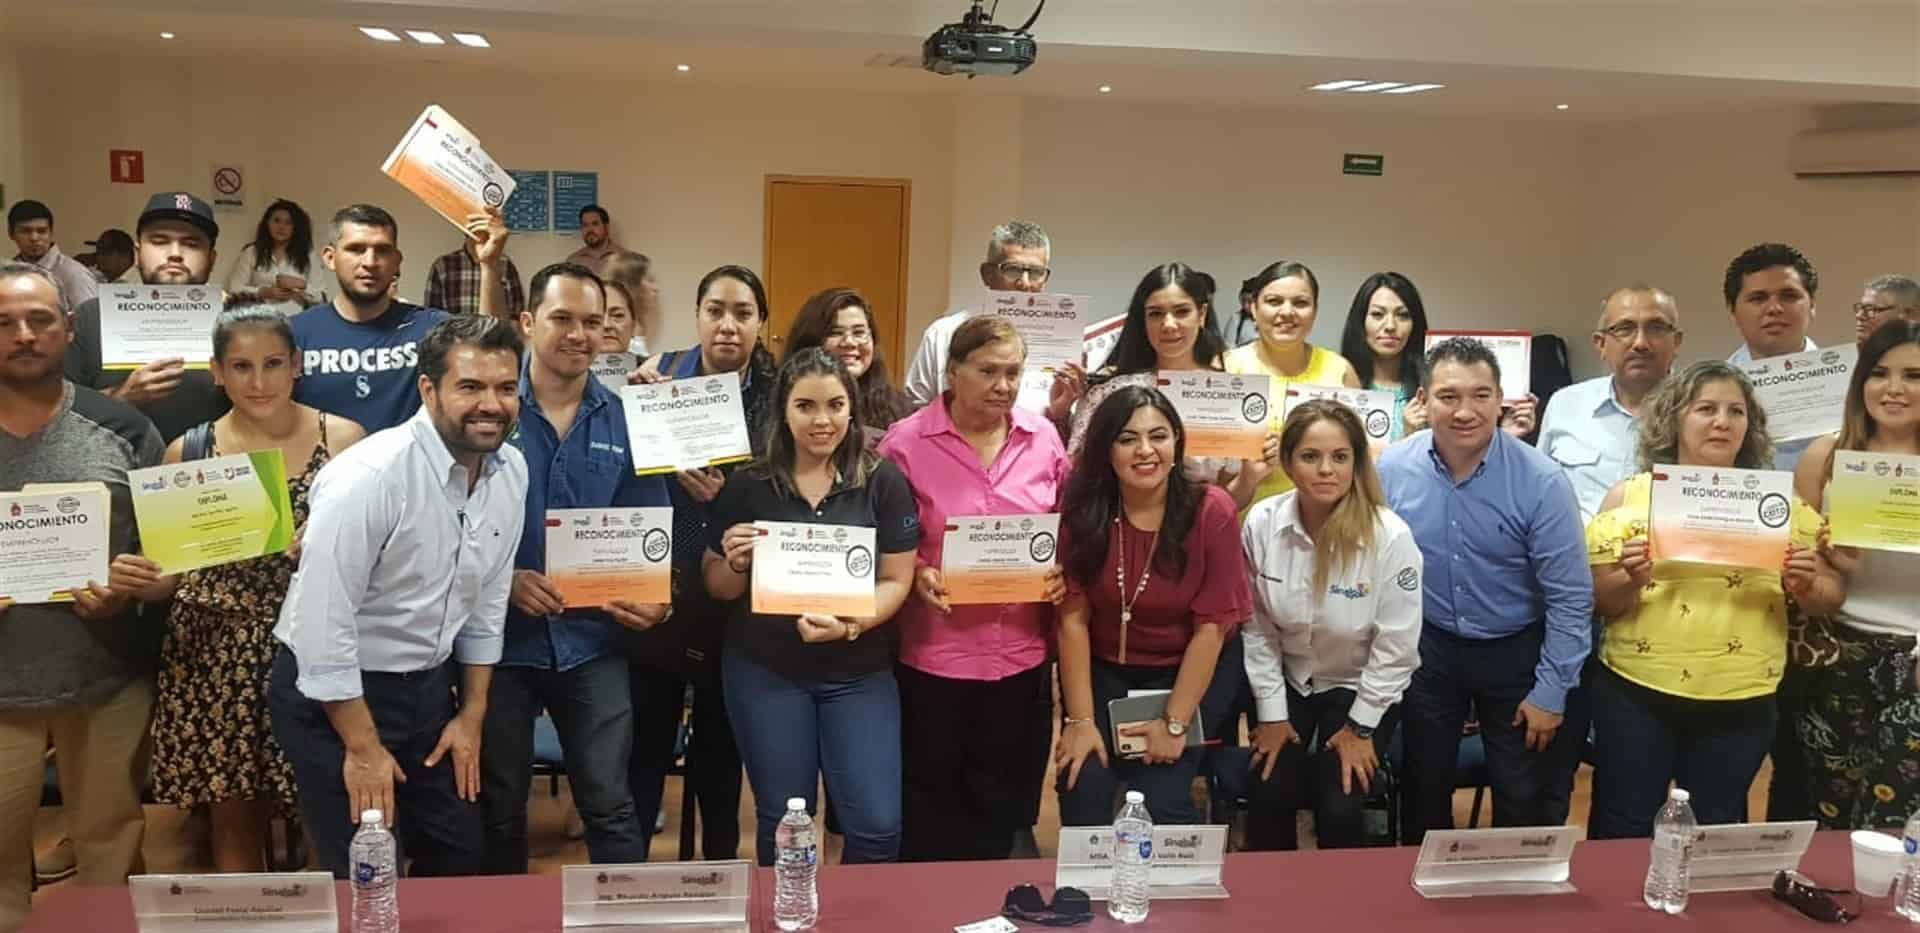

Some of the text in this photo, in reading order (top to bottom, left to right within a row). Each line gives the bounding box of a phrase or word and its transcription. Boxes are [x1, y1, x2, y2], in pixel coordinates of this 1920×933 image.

[117, 302, 212, 312] RECONOCIMIENTO
[997, 307, 1077, 319] RECONOCIMIENTO
[303, 341, 419, 376] PROCESS
[641, 393, 730, 413] RECONOCIMIENTO
